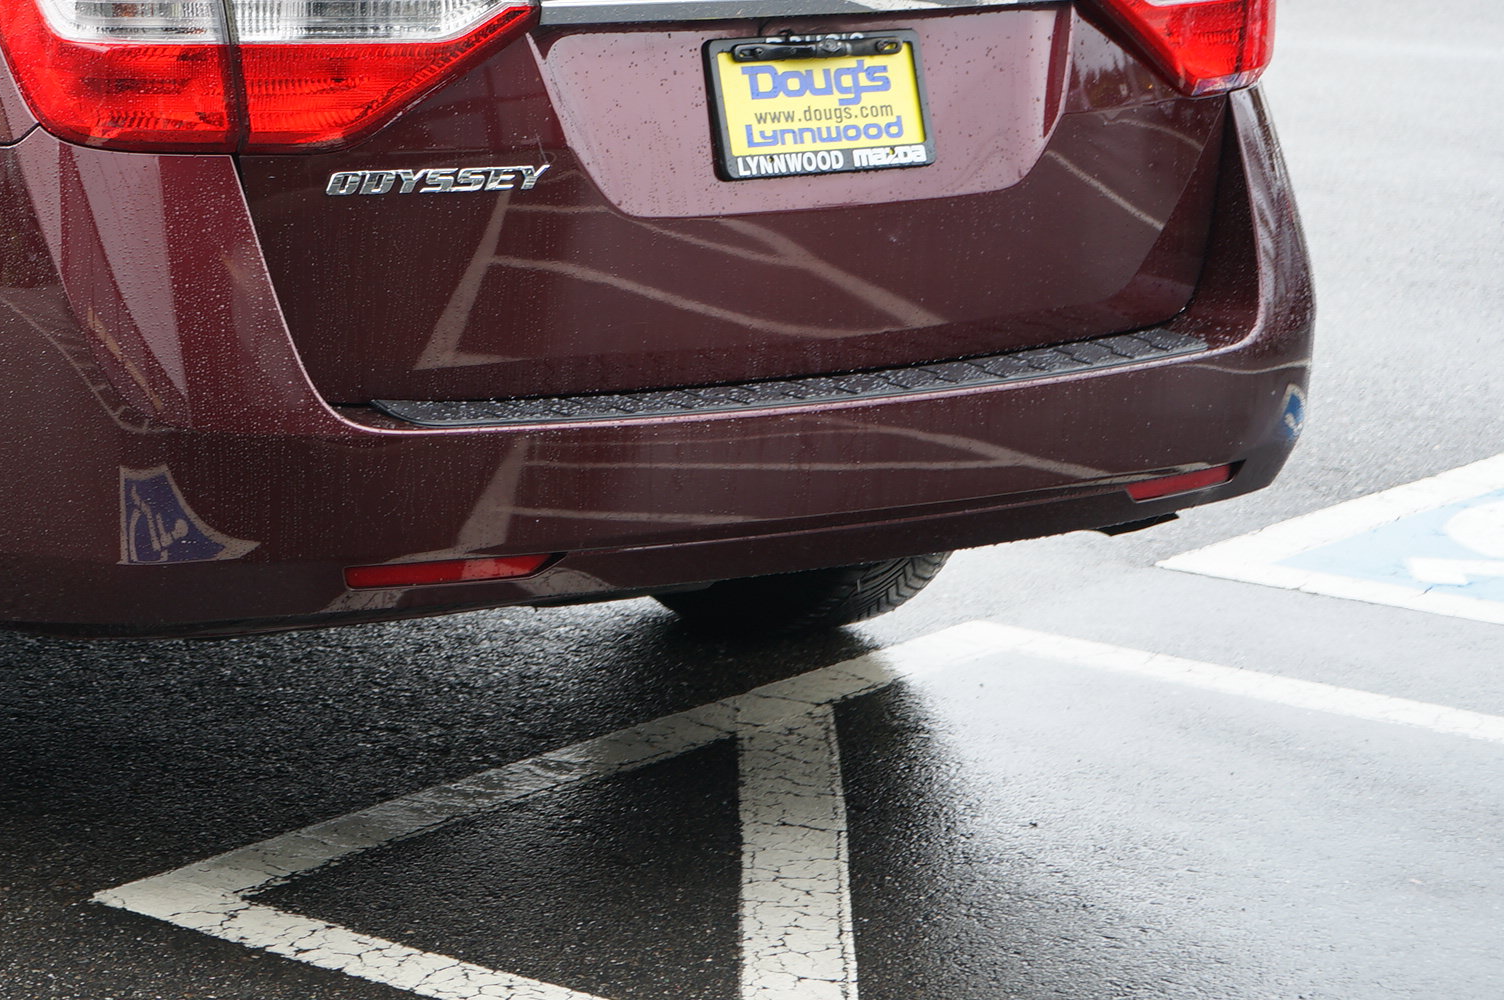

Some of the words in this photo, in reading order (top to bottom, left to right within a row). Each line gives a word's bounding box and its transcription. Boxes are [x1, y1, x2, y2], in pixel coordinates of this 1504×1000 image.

[754, 103, 894, 125] www.dougs.com
[744, 115, 904, 148] Lynnwood
[736, 150, 845, 177] LYNNWOOD
[325, 164, 551, 196] ODYSSEY
